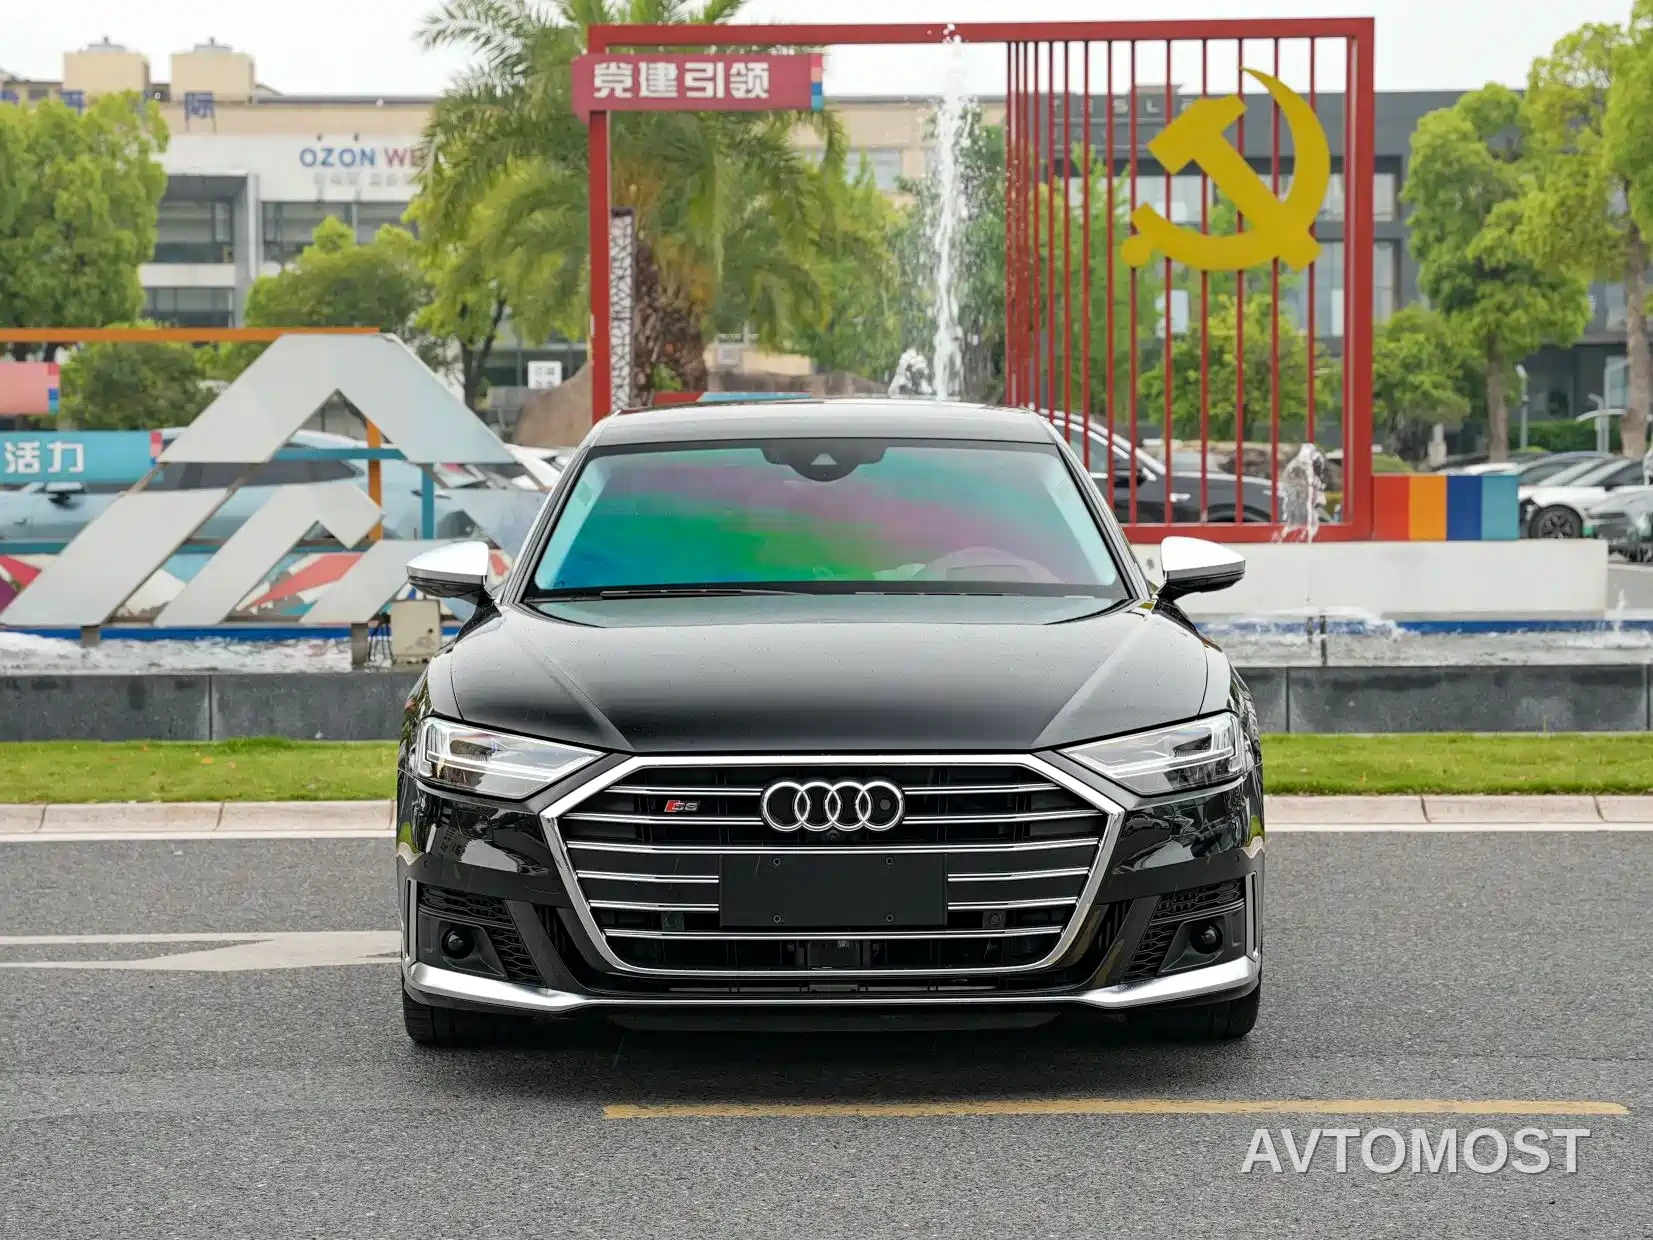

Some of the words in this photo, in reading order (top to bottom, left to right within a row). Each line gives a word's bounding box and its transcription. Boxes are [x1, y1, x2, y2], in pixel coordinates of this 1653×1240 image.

[593, 61, 770, 99] 党建引领
[299, 148, 376, 168] OZON
[4, 440, 85, 474] 活力
